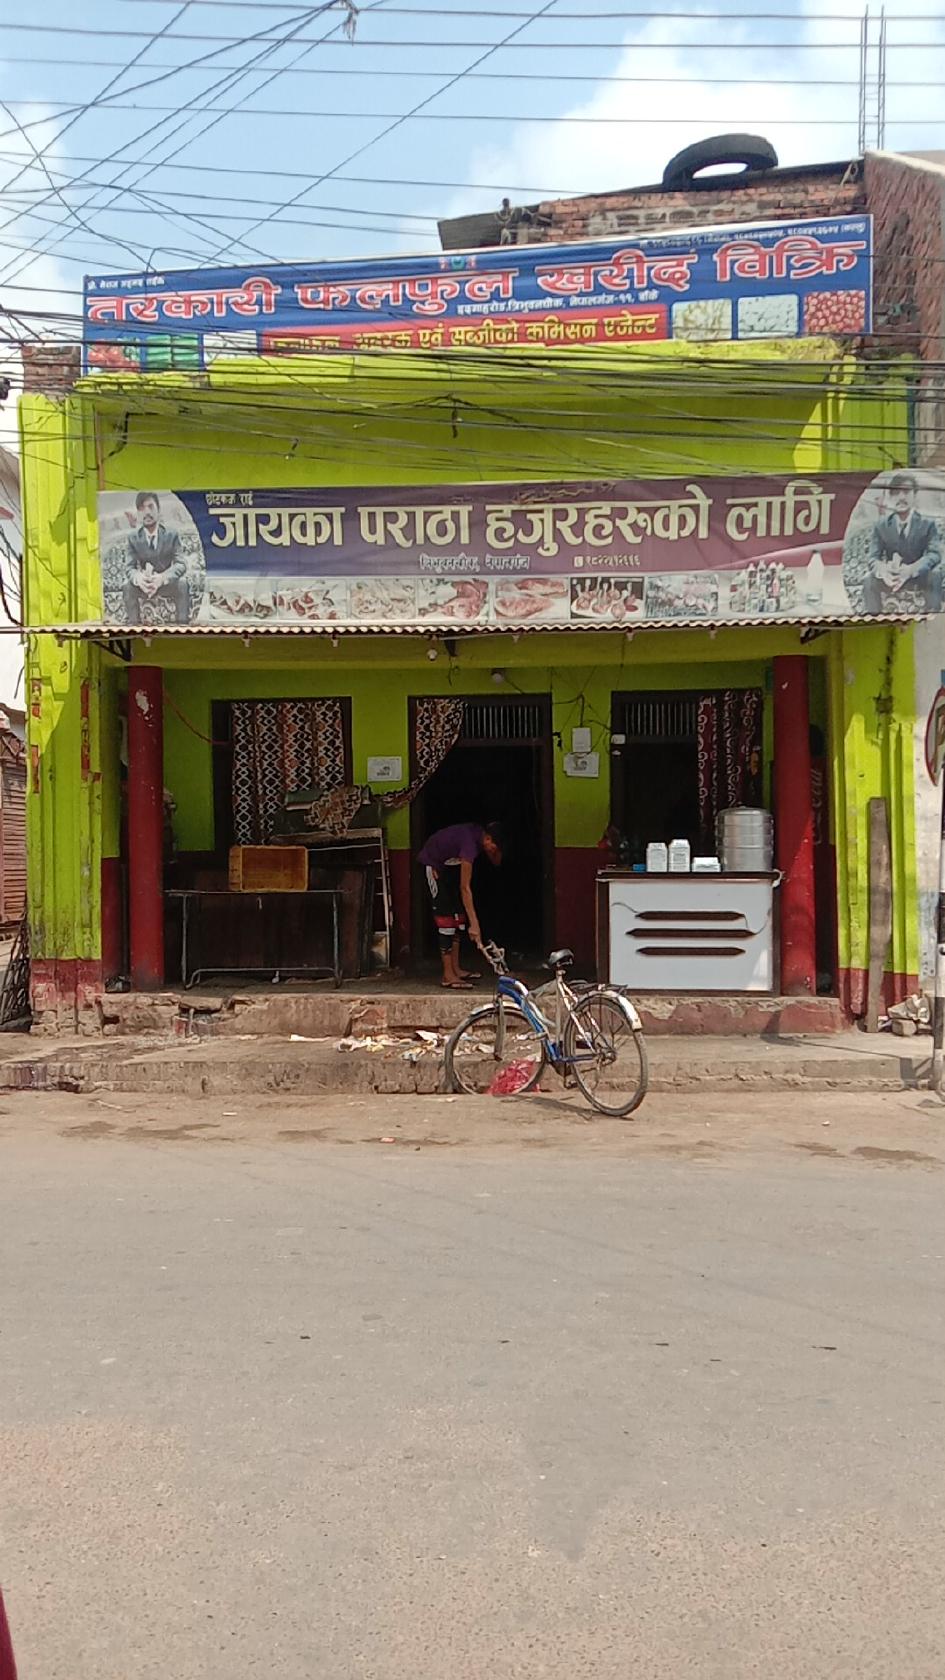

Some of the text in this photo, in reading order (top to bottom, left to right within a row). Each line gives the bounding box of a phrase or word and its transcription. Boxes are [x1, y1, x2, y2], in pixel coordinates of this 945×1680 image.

[86, 276, 281, 323] तरकारी
[294, 266, 519, 315] फलफुल
[535, 248, 699, 294] खरीद
[417, 322, 445, 348] एवं
[525, 315, 598, 342] कमिसन
[603, 310, 660, 337] एजेन्ट
[207, 505, 346, 549] जायका
[357, 503, 473, 549] पराठा
[725, 479, 837, 541] लागि
